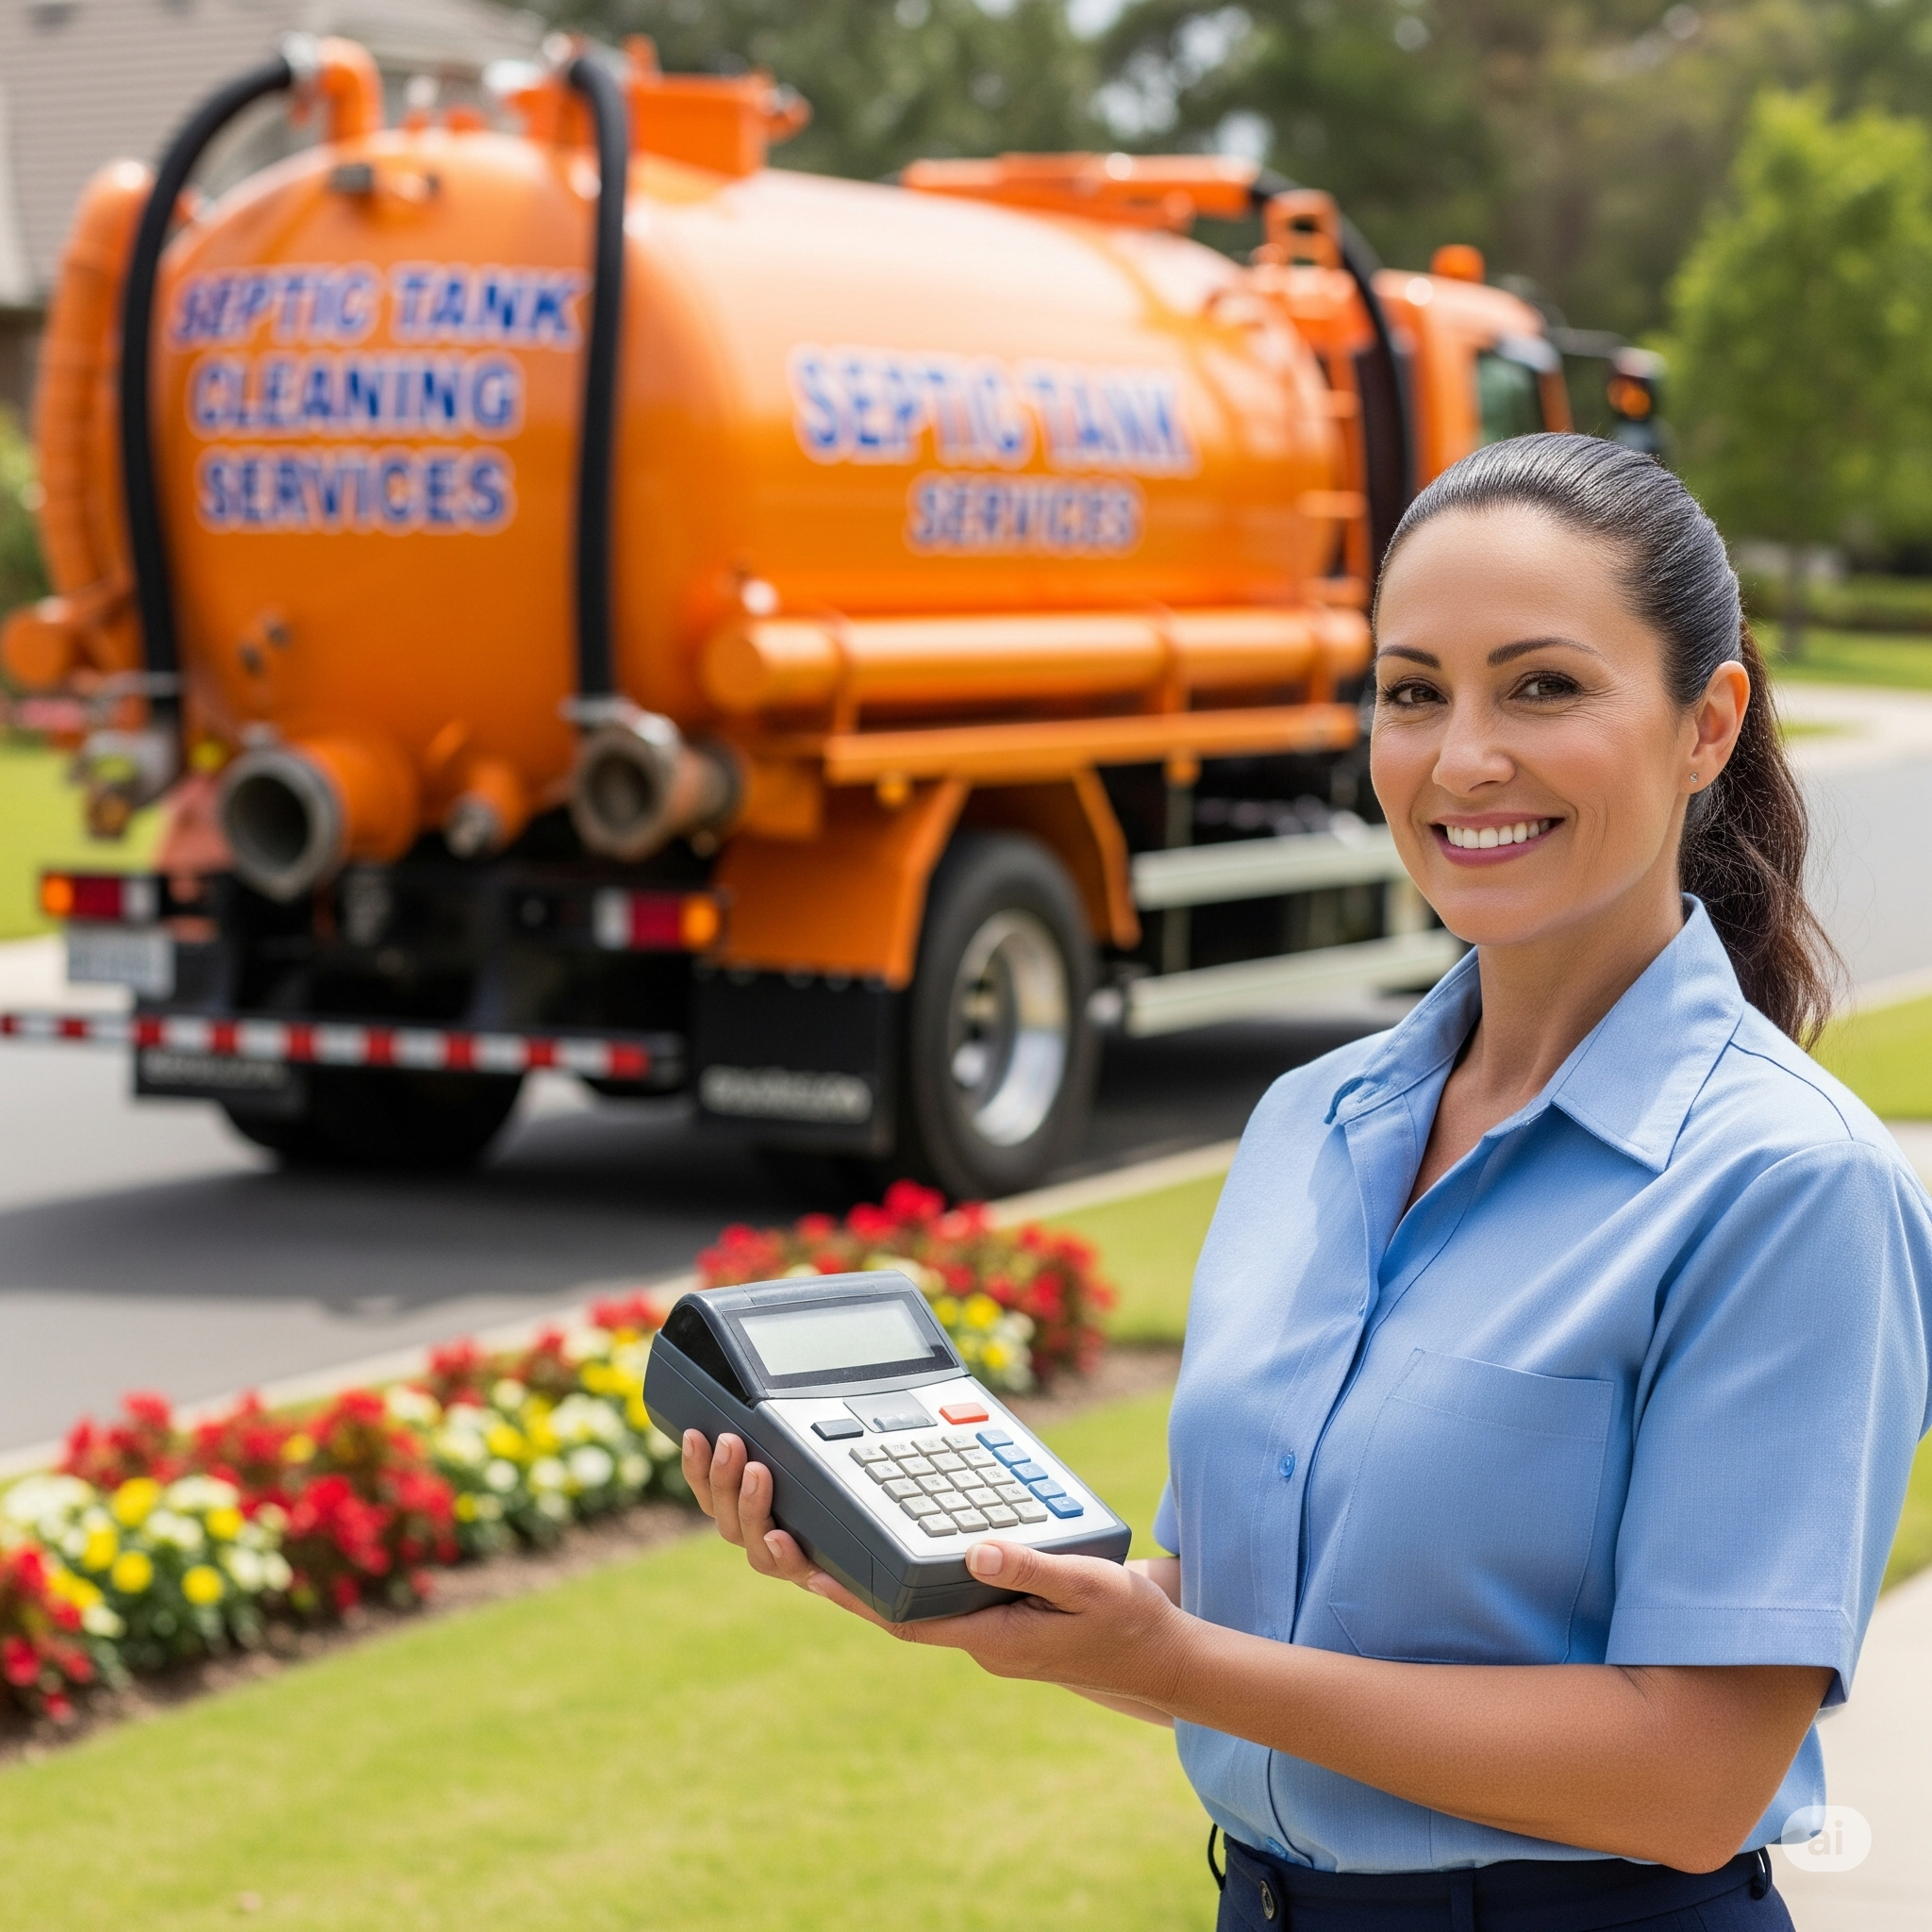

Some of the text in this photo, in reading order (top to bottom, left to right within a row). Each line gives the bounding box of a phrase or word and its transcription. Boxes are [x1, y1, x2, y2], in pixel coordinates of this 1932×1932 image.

[170, 266, 585, 349] SEPTIC TANK
[192, 357, 520, 435] CLEANING
[791, 349, 1028, 466] SEPTIC
[200, 450, 512, 529] SERVICES
[908, 477, 1141, 553] SERVICES
